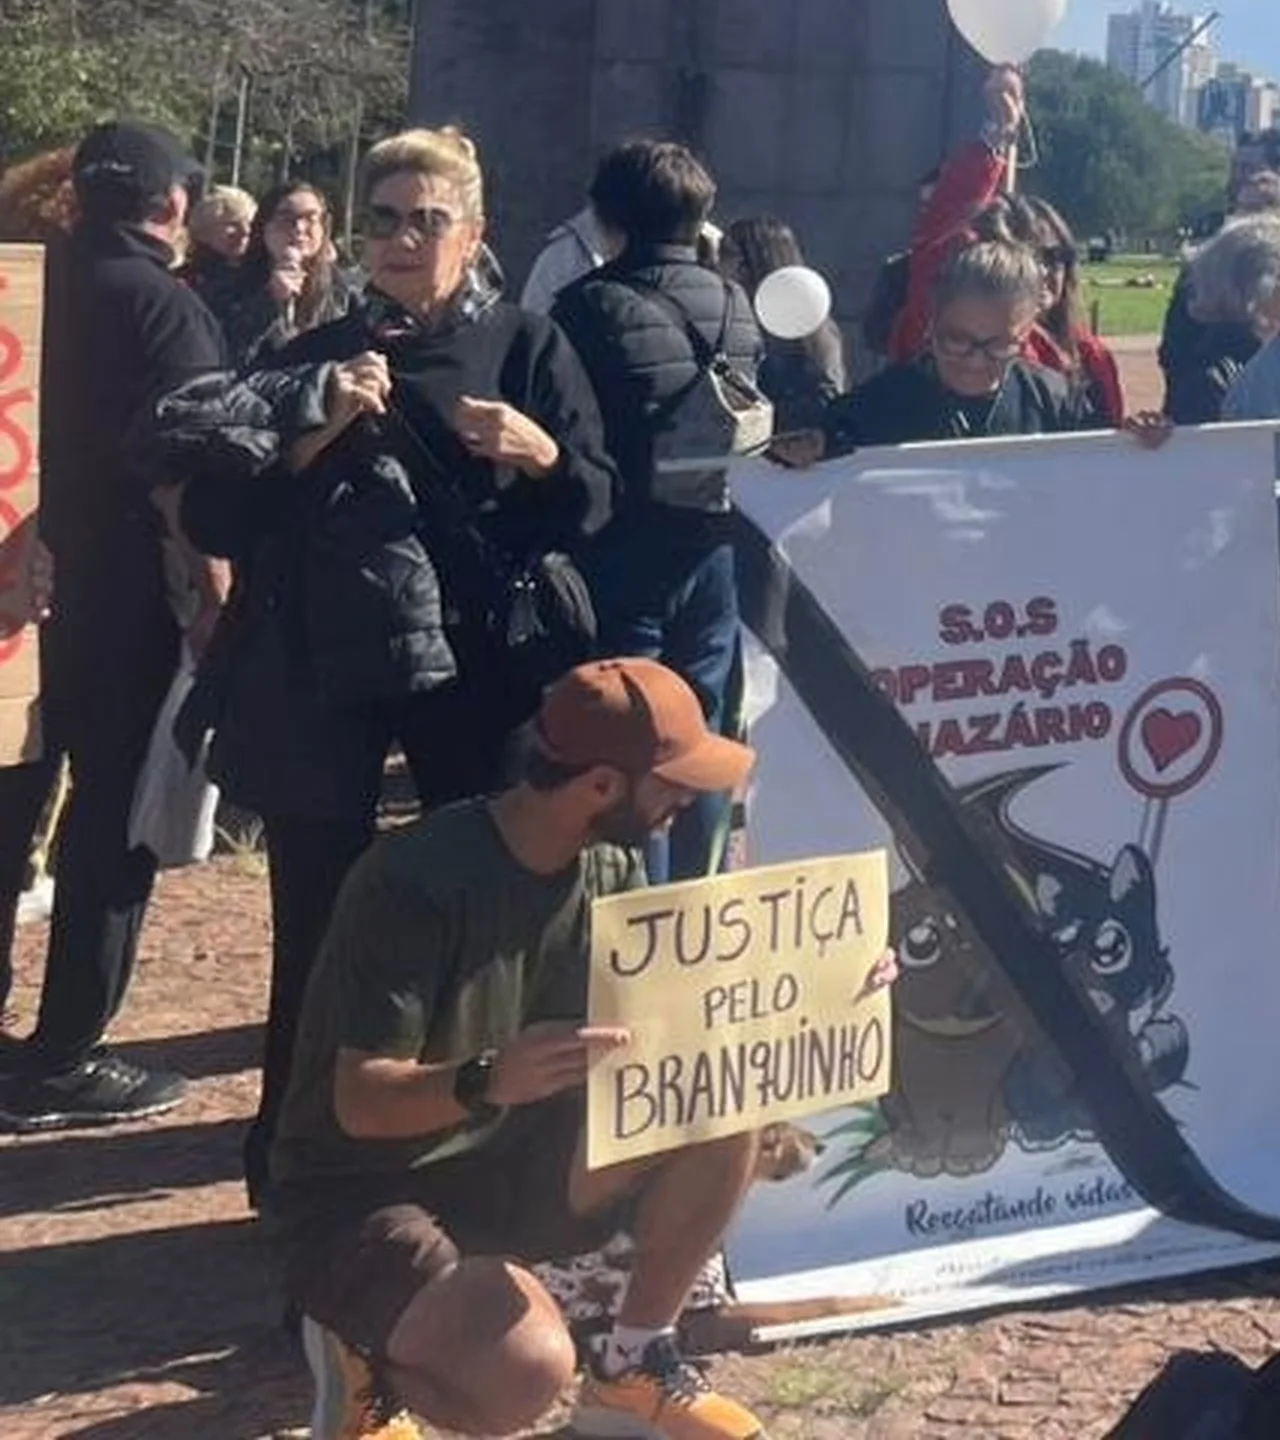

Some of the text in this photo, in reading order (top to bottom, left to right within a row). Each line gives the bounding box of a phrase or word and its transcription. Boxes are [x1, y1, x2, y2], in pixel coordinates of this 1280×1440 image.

[938, 596, 1059, 645] S.O.S
[868, 638, 1127, 708] OPERAÇÃO
[703, 973, 798, 1030] PELO
